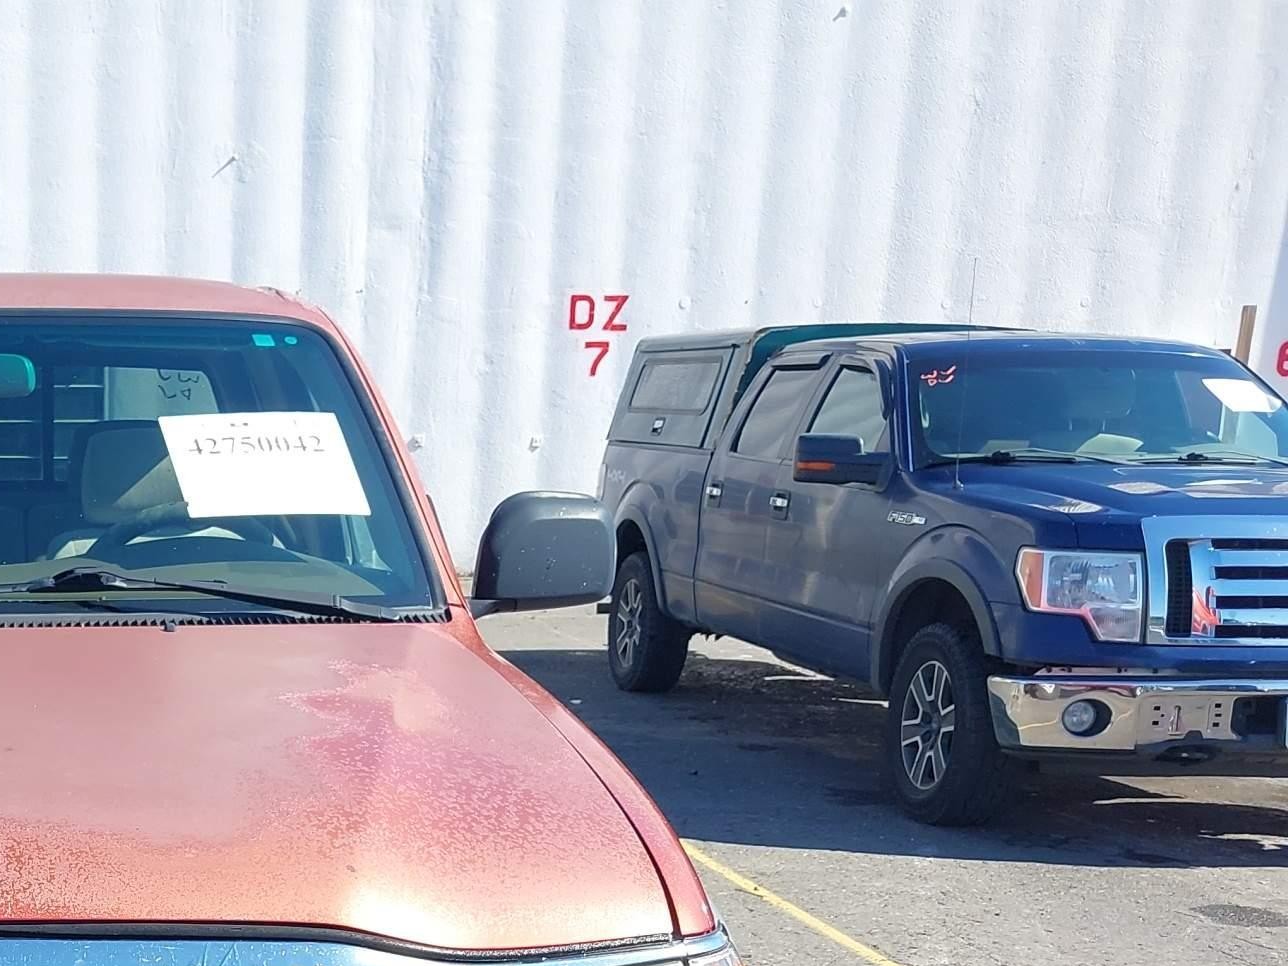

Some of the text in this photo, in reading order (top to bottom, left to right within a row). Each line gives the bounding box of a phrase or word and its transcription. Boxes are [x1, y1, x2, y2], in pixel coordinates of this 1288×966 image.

[569, 294, 630, 331] DZ
[584, 341, 610, 377] 7
[188, 435, 325, 455] 42750042
